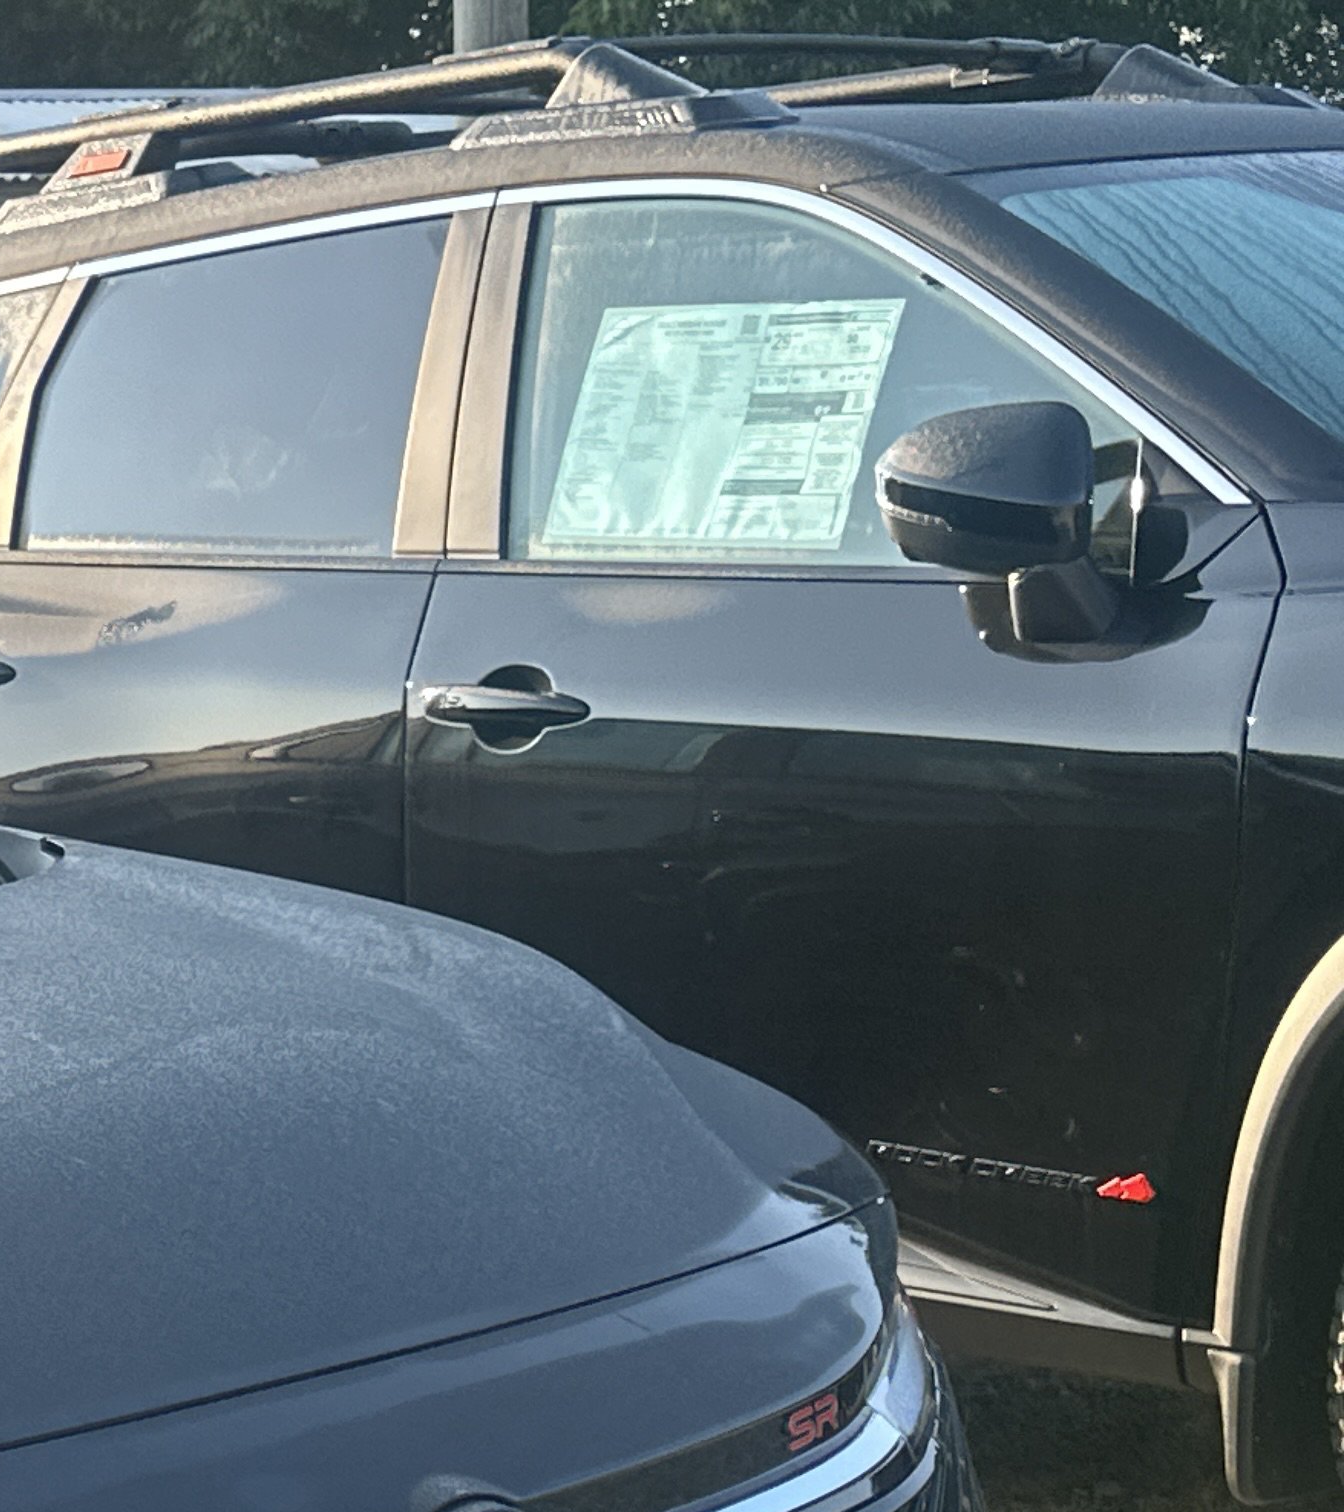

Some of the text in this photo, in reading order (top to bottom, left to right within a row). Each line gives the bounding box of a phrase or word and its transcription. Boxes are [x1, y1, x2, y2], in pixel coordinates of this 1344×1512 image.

[867, 1139, 1098, 1192] ROCK CREEK
[788, 1394, 839, 1451] SR
